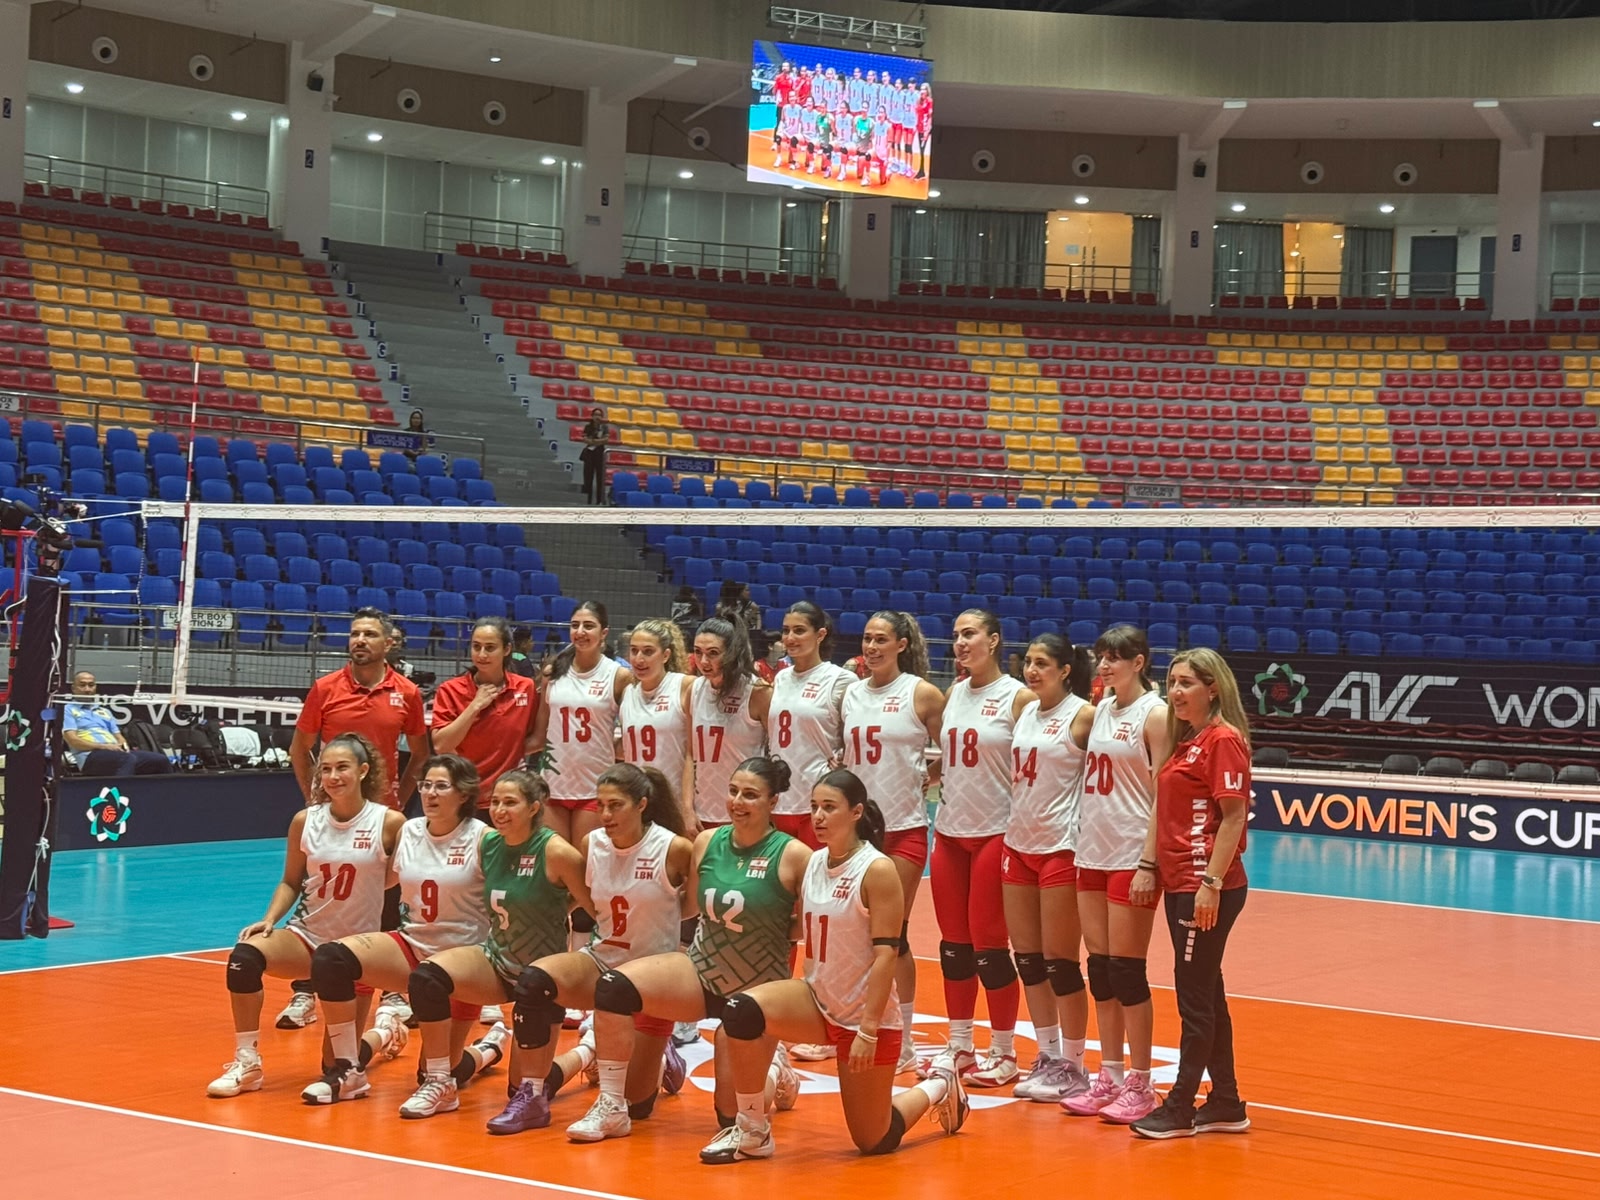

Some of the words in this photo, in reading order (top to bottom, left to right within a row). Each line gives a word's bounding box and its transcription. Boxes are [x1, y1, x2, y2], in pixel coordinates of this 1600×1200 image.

[305, 150, 313, 167] 2
[368, 321, 377, 337] H
[401, 385, 411, 402] E
[169, 611, 204, 620] LOER
[206, 613, 227, 621] BOX
[174, 619, 214, 627] STION
[802, 691, 817, 699] LBN
[1315, 671, 1459, 725] AVC
[655, 703, 669, 712] LBN
[723, 706, 738, 714] LBN
[883, 705, 899, 713] LBN
[981, 708, 997, 717] LBN
[560, 706, 592, 743] 13
[778, 709, 792, 748] 8
[1042, 727, 1059, 736] LBN
[627, 725, 657, 762] 19
[696, 725, 725, 763] 17
[851, 725, 883, 765] 15
[1113, 732, 1129, 742] LBN
[947, 727, 979, 768] 18
[1012, 746, 1038, 787] 14
[1084, 751, 1115, 796] 20
[1271, 789, 1498, 842] WOMEN'S
[352, 841, 372, 850] LBN
[1190, 799, 1208, 877] LEBANON
[446, 856, 465, 866] LBN
[517, 867, 534, 877] LBN
[634, 870, 653, 880] LBN
[745, 869, 766, 880] LBN
[317, 863, 357, 901] 10
[420, 879, 439, 923] 9
[831, 890, 850, 900] LBN
[490, 889, 510, 931] 5
[610, 895, 630, 937] 6
[704, 887, 745, 933] 12
[804, 911, 829, 964] 11
